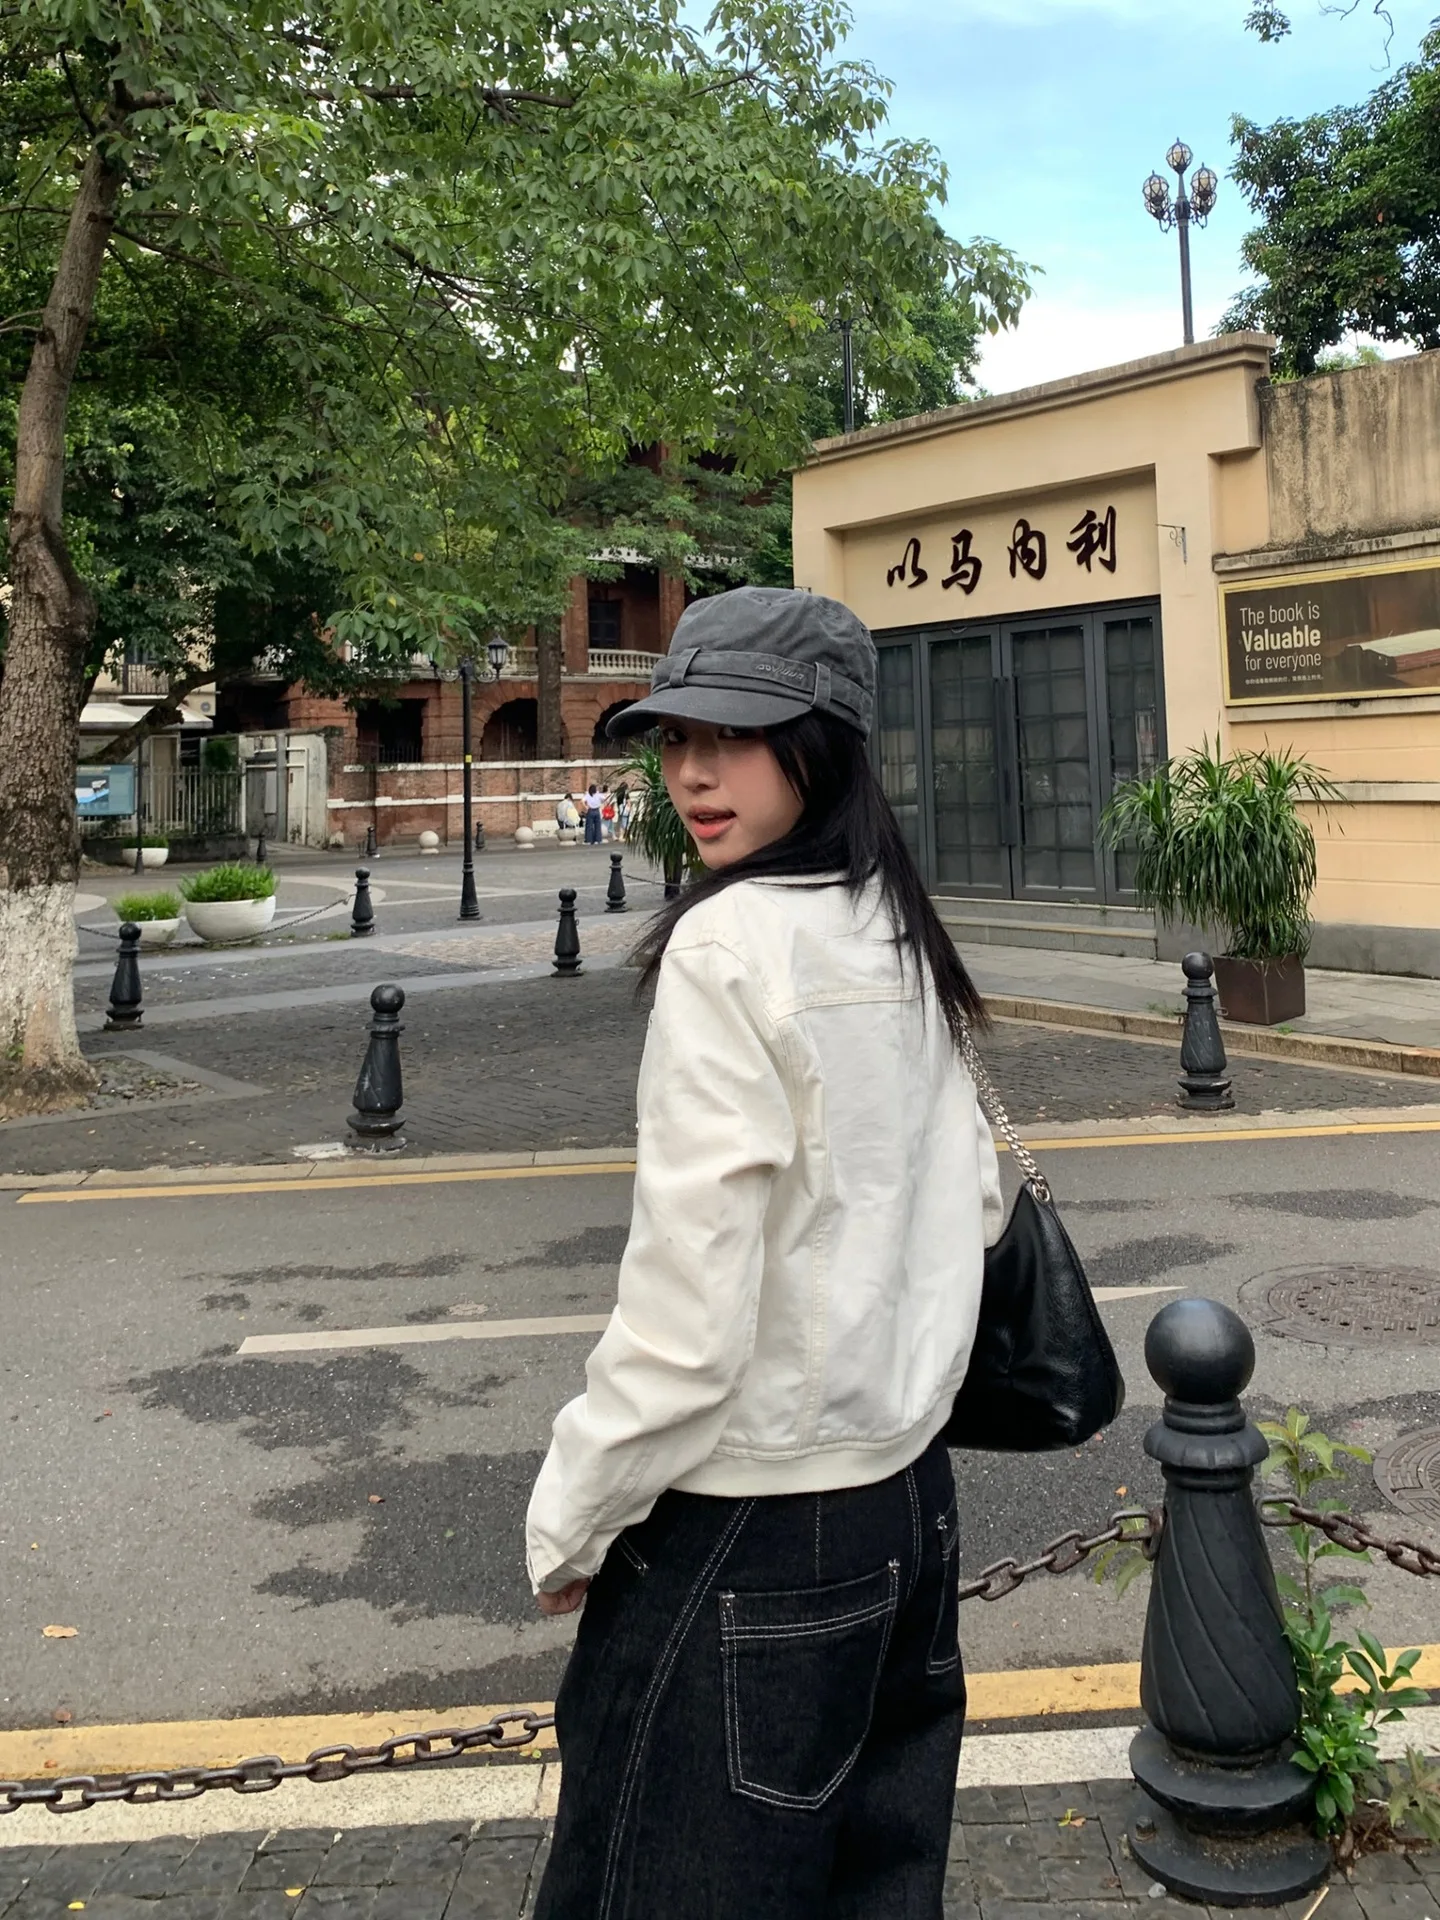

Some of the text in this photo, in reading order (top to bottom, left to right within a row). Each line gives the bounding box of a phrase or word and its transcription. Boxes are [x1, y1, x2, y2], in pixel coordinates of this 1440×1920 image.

[887, 505, 1117, 595] 以马内利
[1240, 600, 1320, 626] The book is
[1241, 624, 1321, 652] Valuable
[1245, 653, 1322, 672] for everyone
